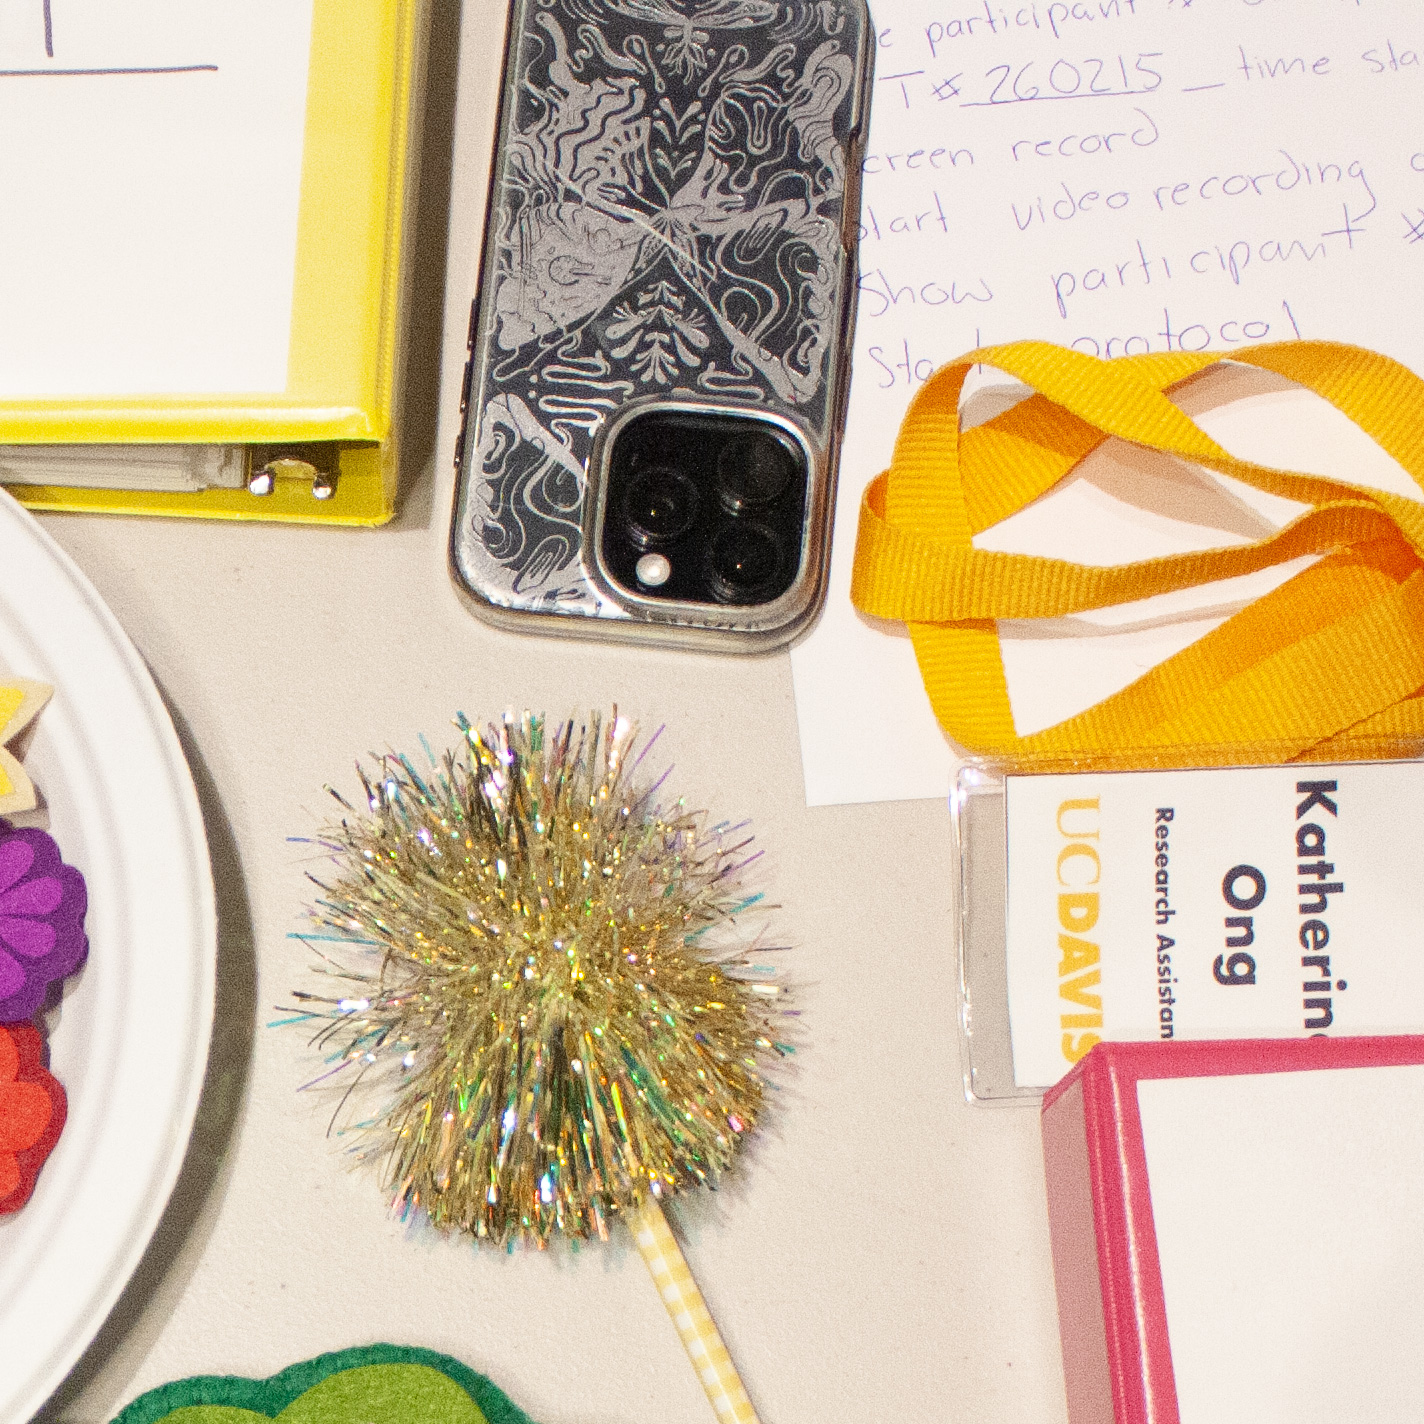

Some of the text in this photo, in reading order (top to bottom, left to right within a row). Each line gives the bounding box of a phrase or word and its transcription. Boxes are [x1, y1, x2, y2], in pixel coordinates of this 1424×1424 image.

[985, 52, 1164, 104] 260215
[1237, 44, 1331, 80] time
[1361, 38, 1423, 73] sta
[862, 107, 1159, 174] creen record
[1012, 182, 1130, 231] video
[1153, 150, 1377, 222] recording
[857, 268, 993, 317] Show
[1051, 202, 1367, 319] participant
[869, 327, 983, 388] Stat
[1155, 807, 1178, 1040] Research Assistan
[1213, 864, 1266, 985] Ong
[1296, 780, 1347, 1038] Katherin
